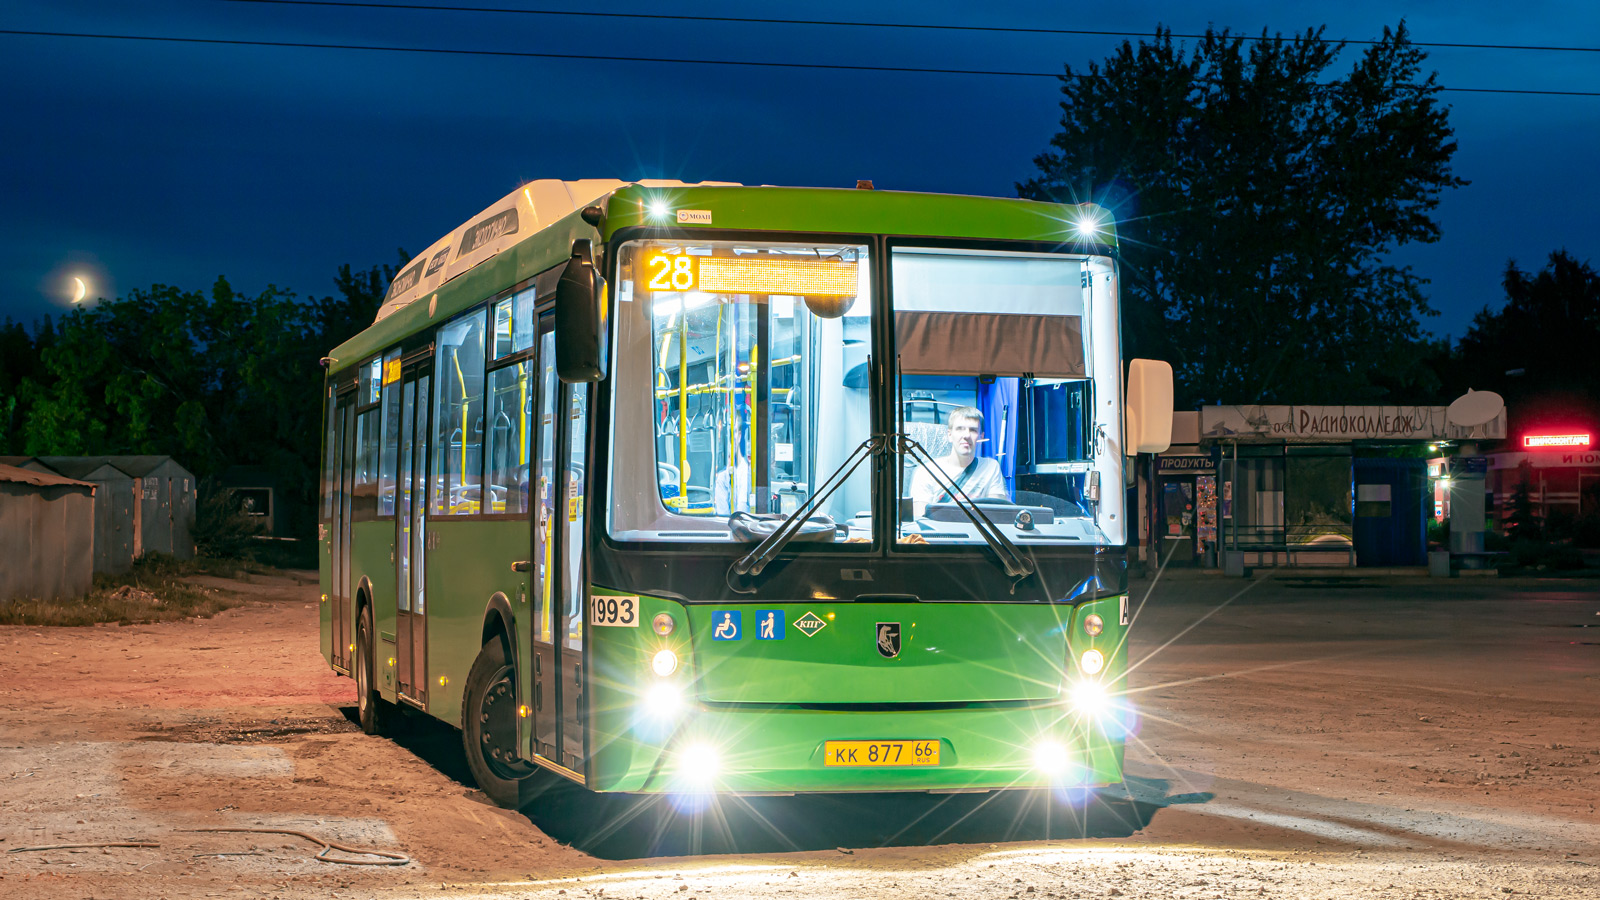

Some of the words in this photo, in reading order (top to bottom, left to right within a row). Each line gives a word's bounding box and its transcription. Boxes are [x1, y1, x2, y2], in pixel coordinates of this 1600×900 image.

[649, 255, 693, 290] 28
[1160, 458, 1215, 468] ПРОДУКТЫ
[591, 598, 635, 624] 1993
[800, 620, 821, 629] КПГ
[868, 744, 904, 762] 877
[914, 742, 933, 757] 66
